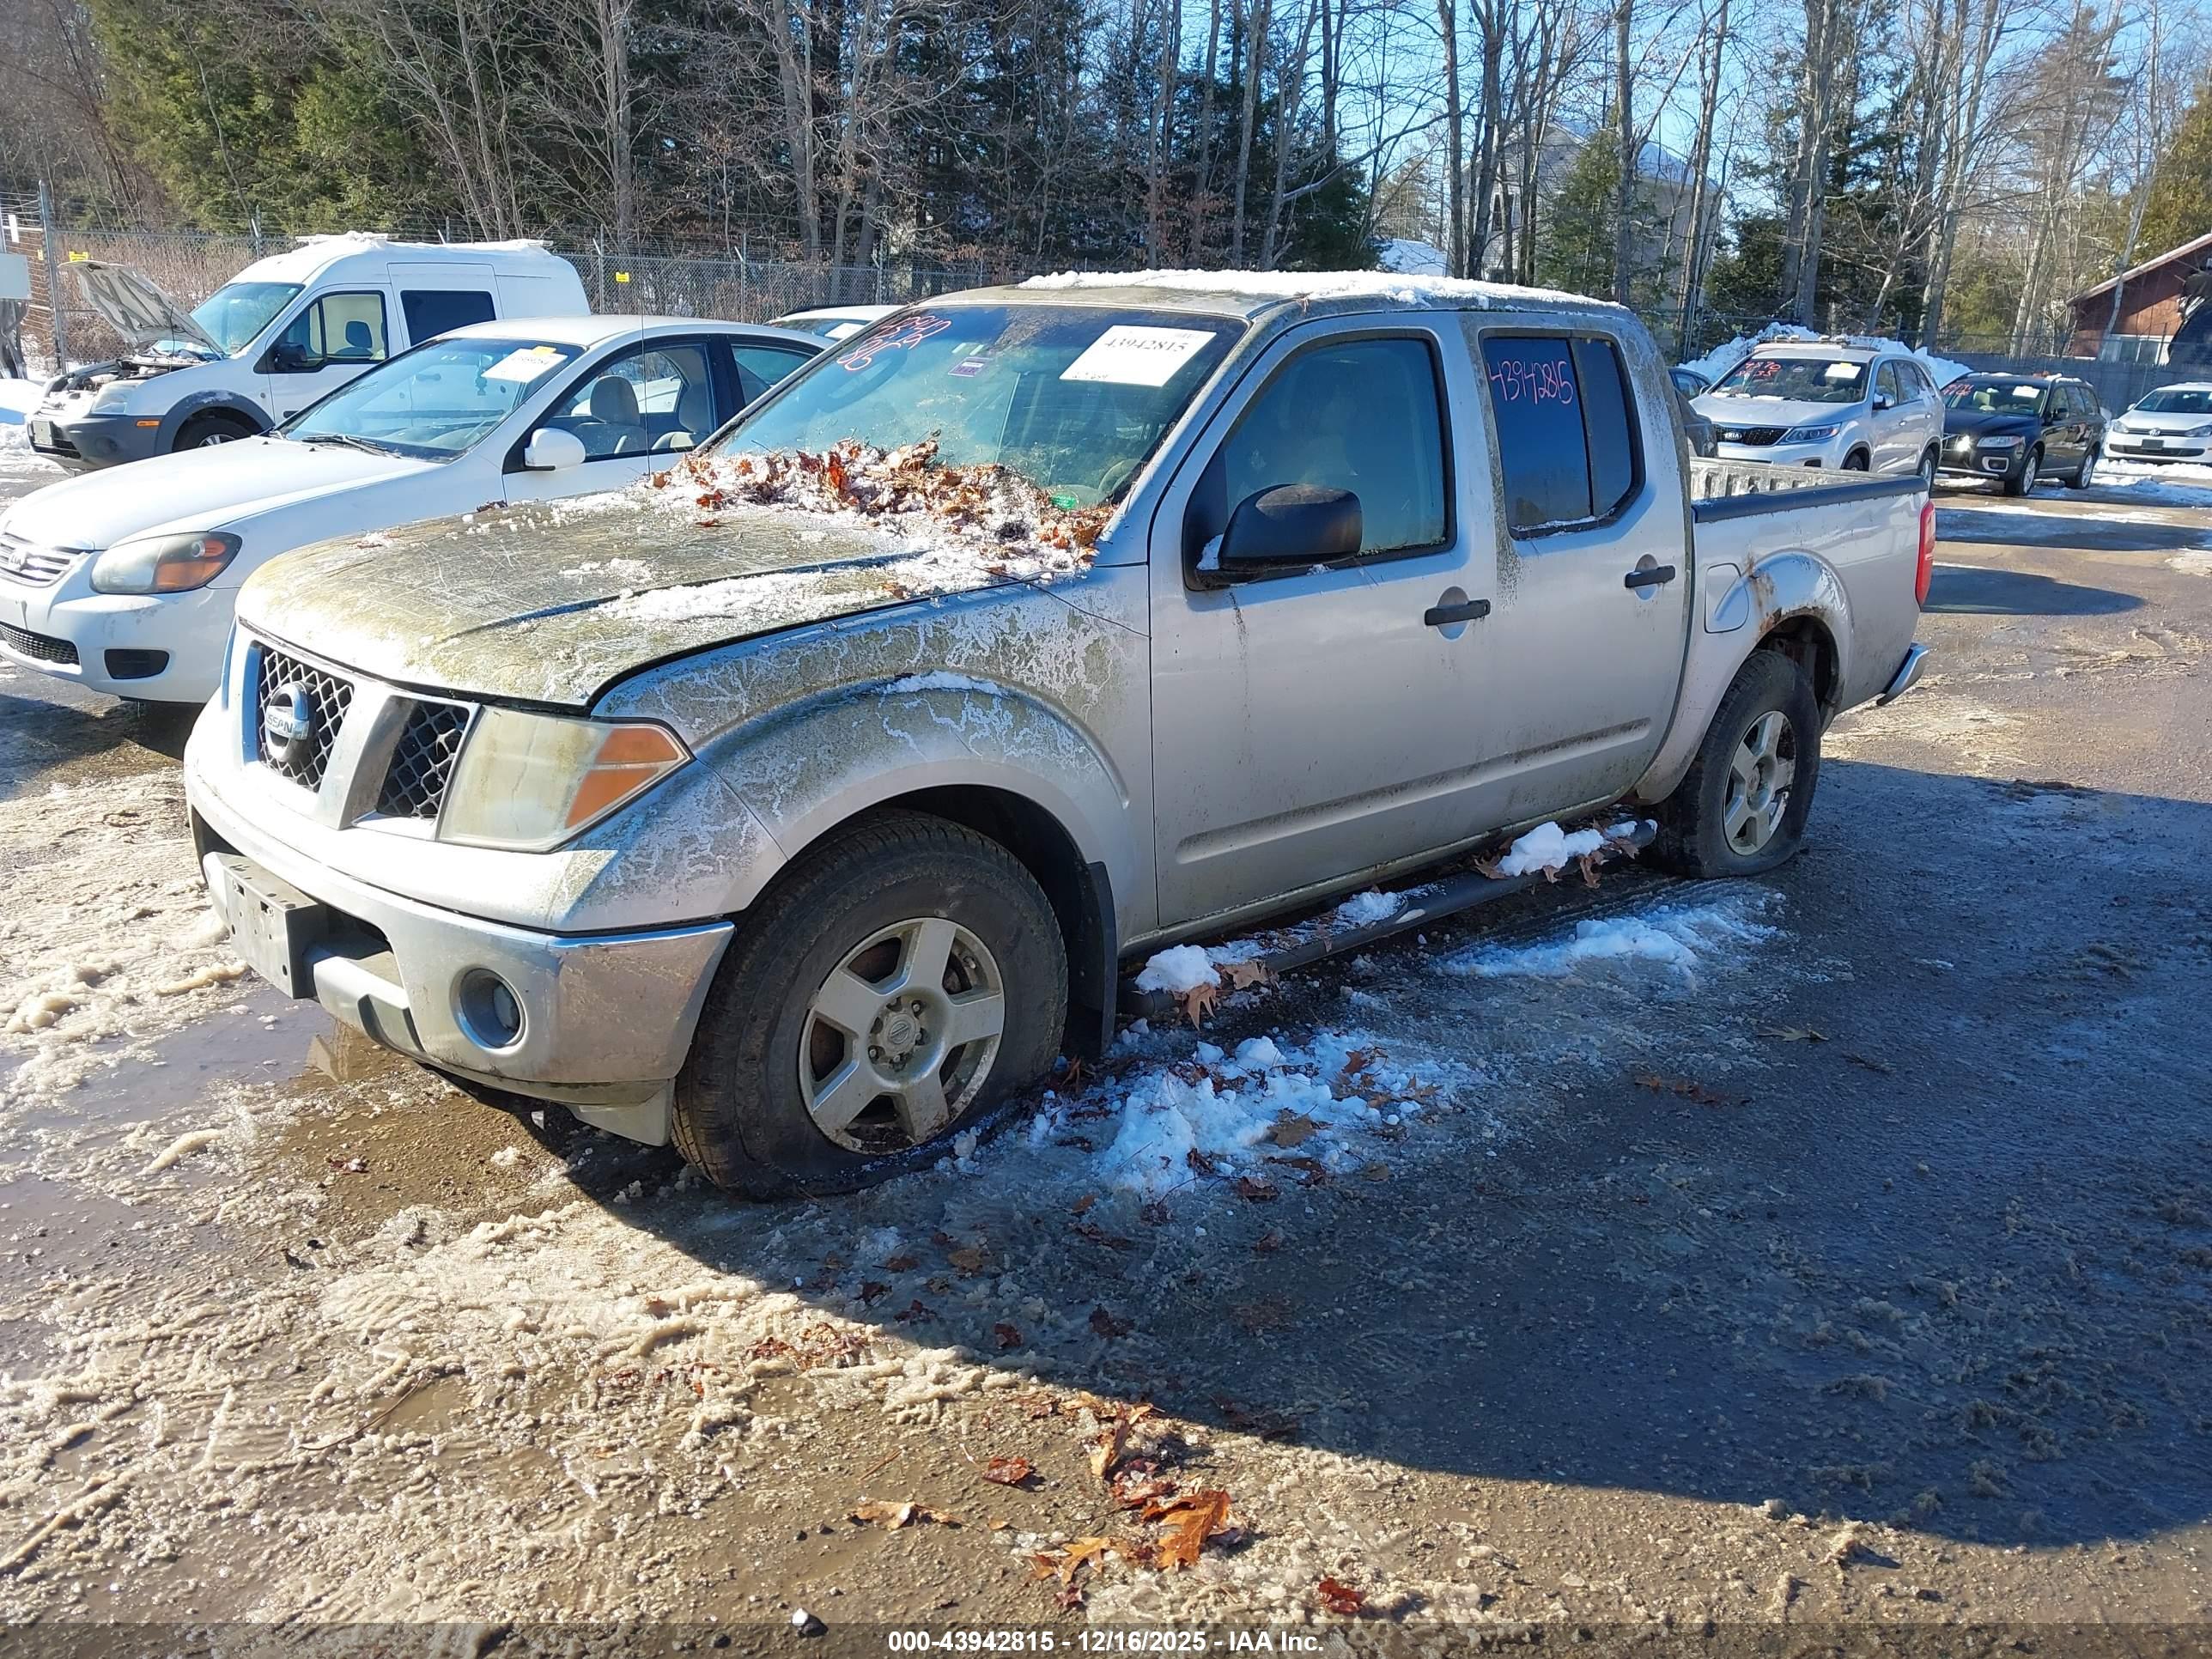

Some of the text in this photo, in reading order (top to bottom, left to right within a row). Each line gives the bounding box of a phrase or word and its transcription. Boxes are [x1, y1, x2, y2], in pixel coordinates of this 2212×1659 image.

[1103, 337, 1190, 352] 43942815
[1486, 360, 1574, 405] 43942815
[266, 714, 294, 733] SSAN
